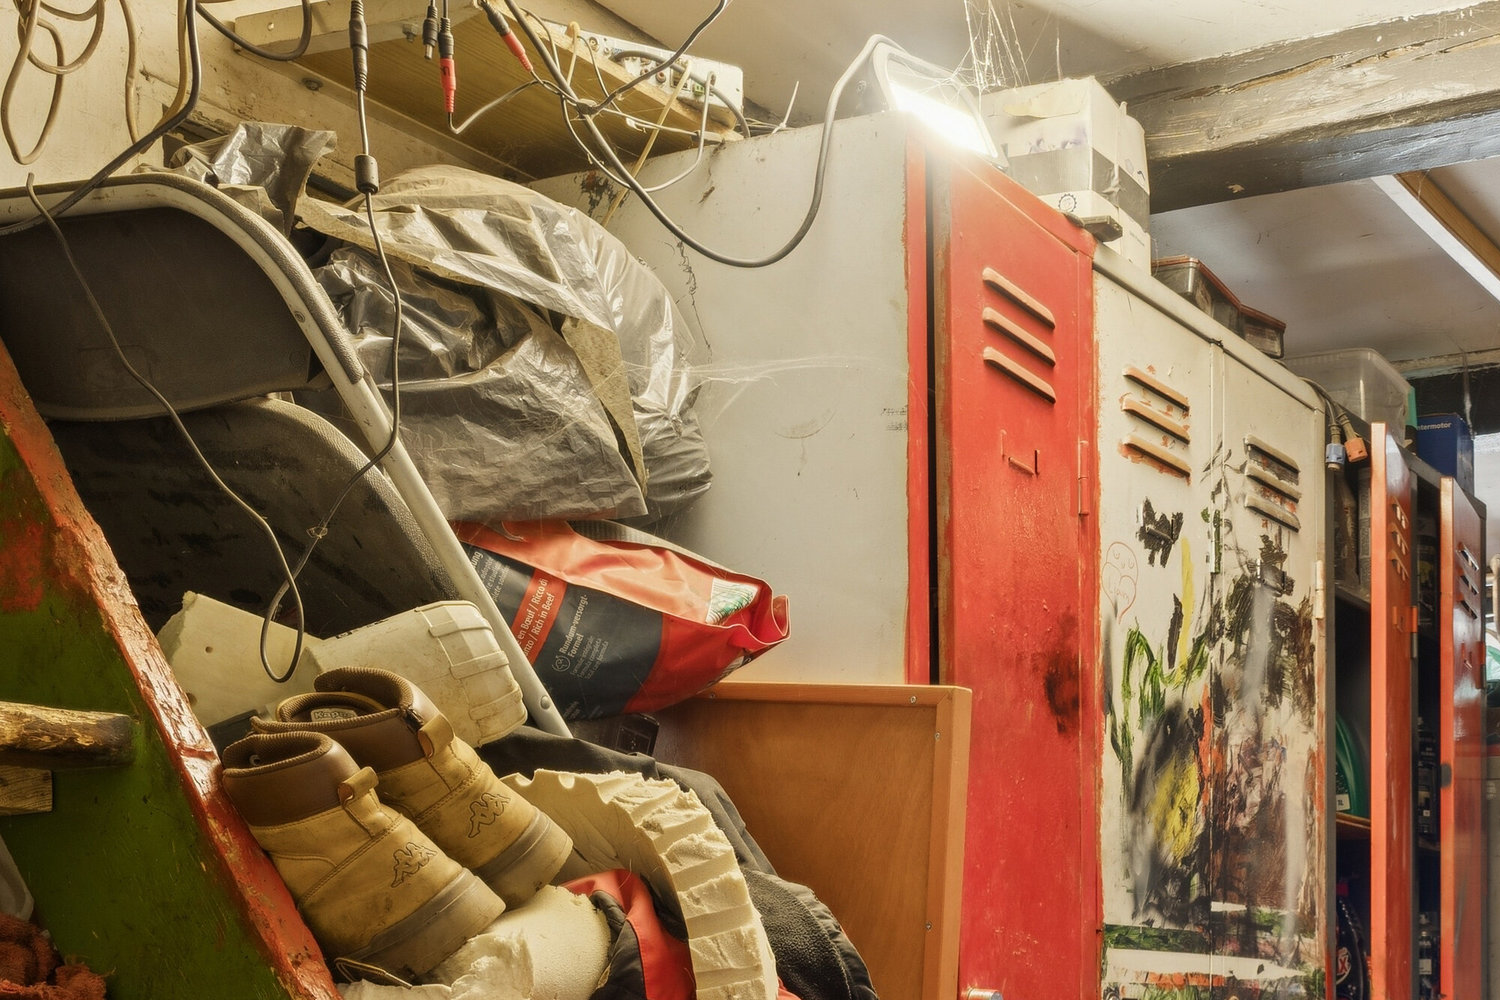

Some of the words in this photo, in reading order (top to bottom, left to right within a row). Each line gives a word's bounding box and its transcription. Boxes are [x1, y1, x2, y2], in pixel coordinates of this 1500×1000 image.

[1416, 421, 1452, 431] ntermotor
[531, 586, 544, 603] Ricco
[542, 593, 554, 609] Beef
[539, 610, 547, 618] in
[532, 619, 543, 634] Rich
[569, 633, 583, 657] Formel
